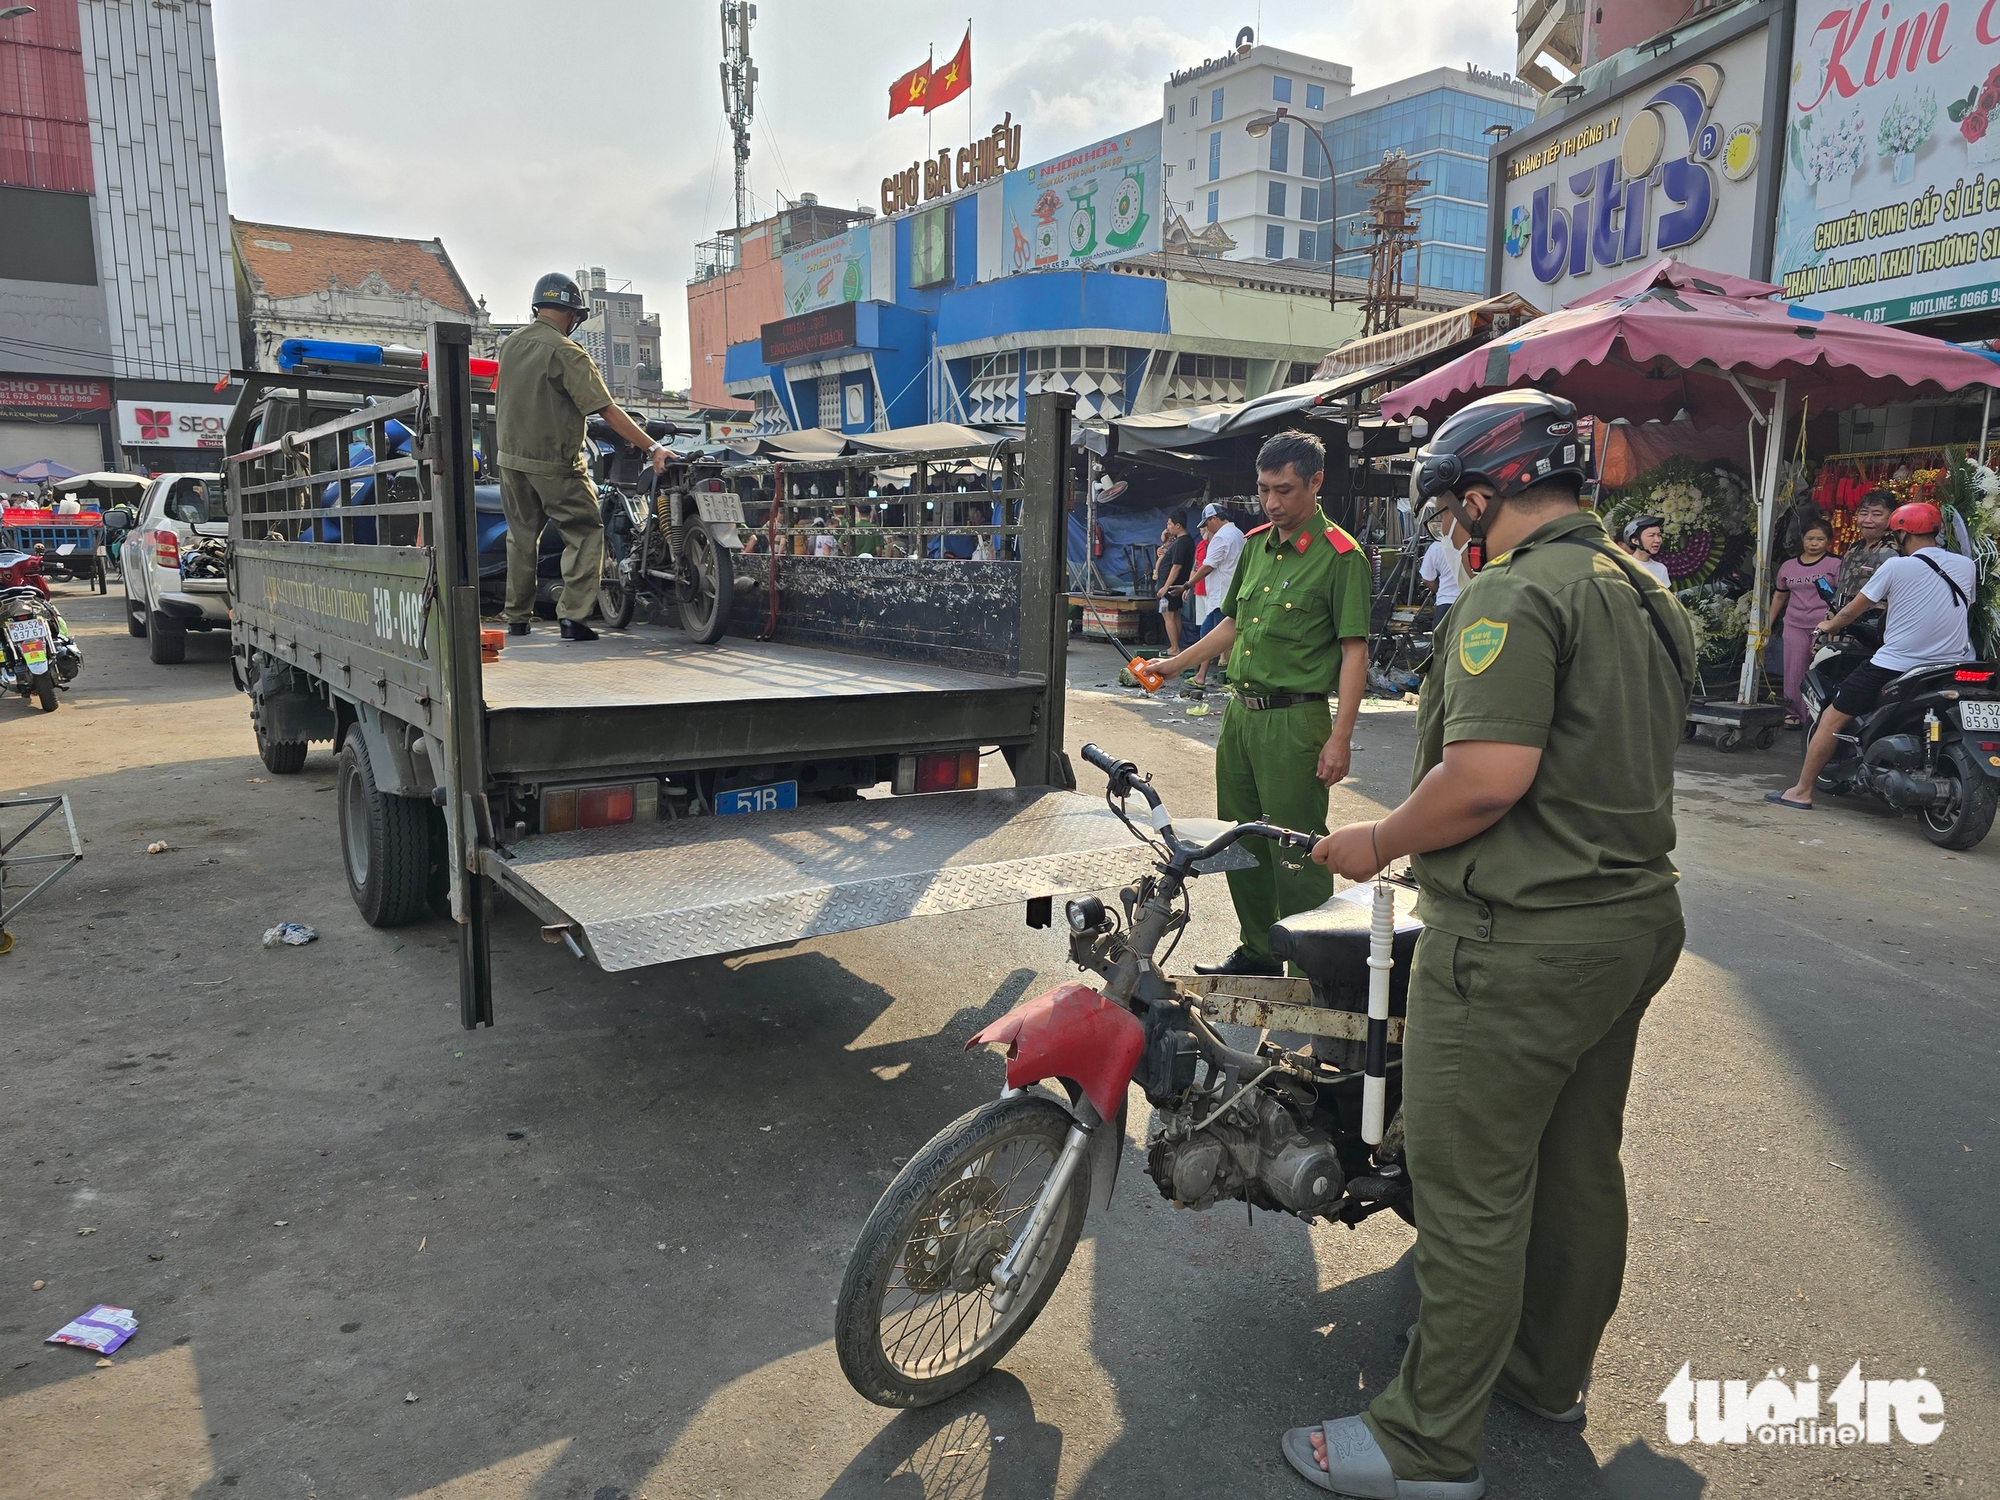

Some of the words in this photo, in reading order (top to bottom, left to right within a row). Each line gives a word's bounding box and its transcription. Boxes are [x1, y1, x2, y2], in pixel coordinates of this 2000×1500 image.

[1169, 50, 1236, 88] VietinBank
[1797, 0, 1952, 112] Kim
[1520, 152, 1541, 174] HÀNG
[1543, 138, 1561, 167] TIẾP
[1562, 140, 1578, 158] THỊ
[1577, 124, 1603, 149] CÔNG
[1605, 117, 1621, 139] TY
[881, 161, 920, 216] CHỢ
[1814, 209, 1867, 252] CHUYÊN
[1868, 201, 1909, 240] CUNG
[1910, 184, 1942, 229] CẤP
[1943, 178, 1964, 222] SỈ
[1964, 172, 1985, 216] LẺ
[1782, 263, 1817, 302] NHẬN
[1818, 257, 1849, 294] LÀM
[1849, 253, 1878, 287] HOA
[1879, 245, 1915, 282] KHAI
[1916, 231, 1979, 275] TRƯƠNG
[1909, 292, 1958, 317] HOTLINE:
[1959, 288, 1988, 309] 0966
[0, 381, 40, 394] CHO
[46, 382, 102, 396] THUÊ
[13, 392, 29, 400] 678
[36, 393, 57, 401] 0903
[59, 394, 75, 402] 905
[337, 582, 370, 626] THÔNG
[1965, 716, 1999, 729] 853.9
